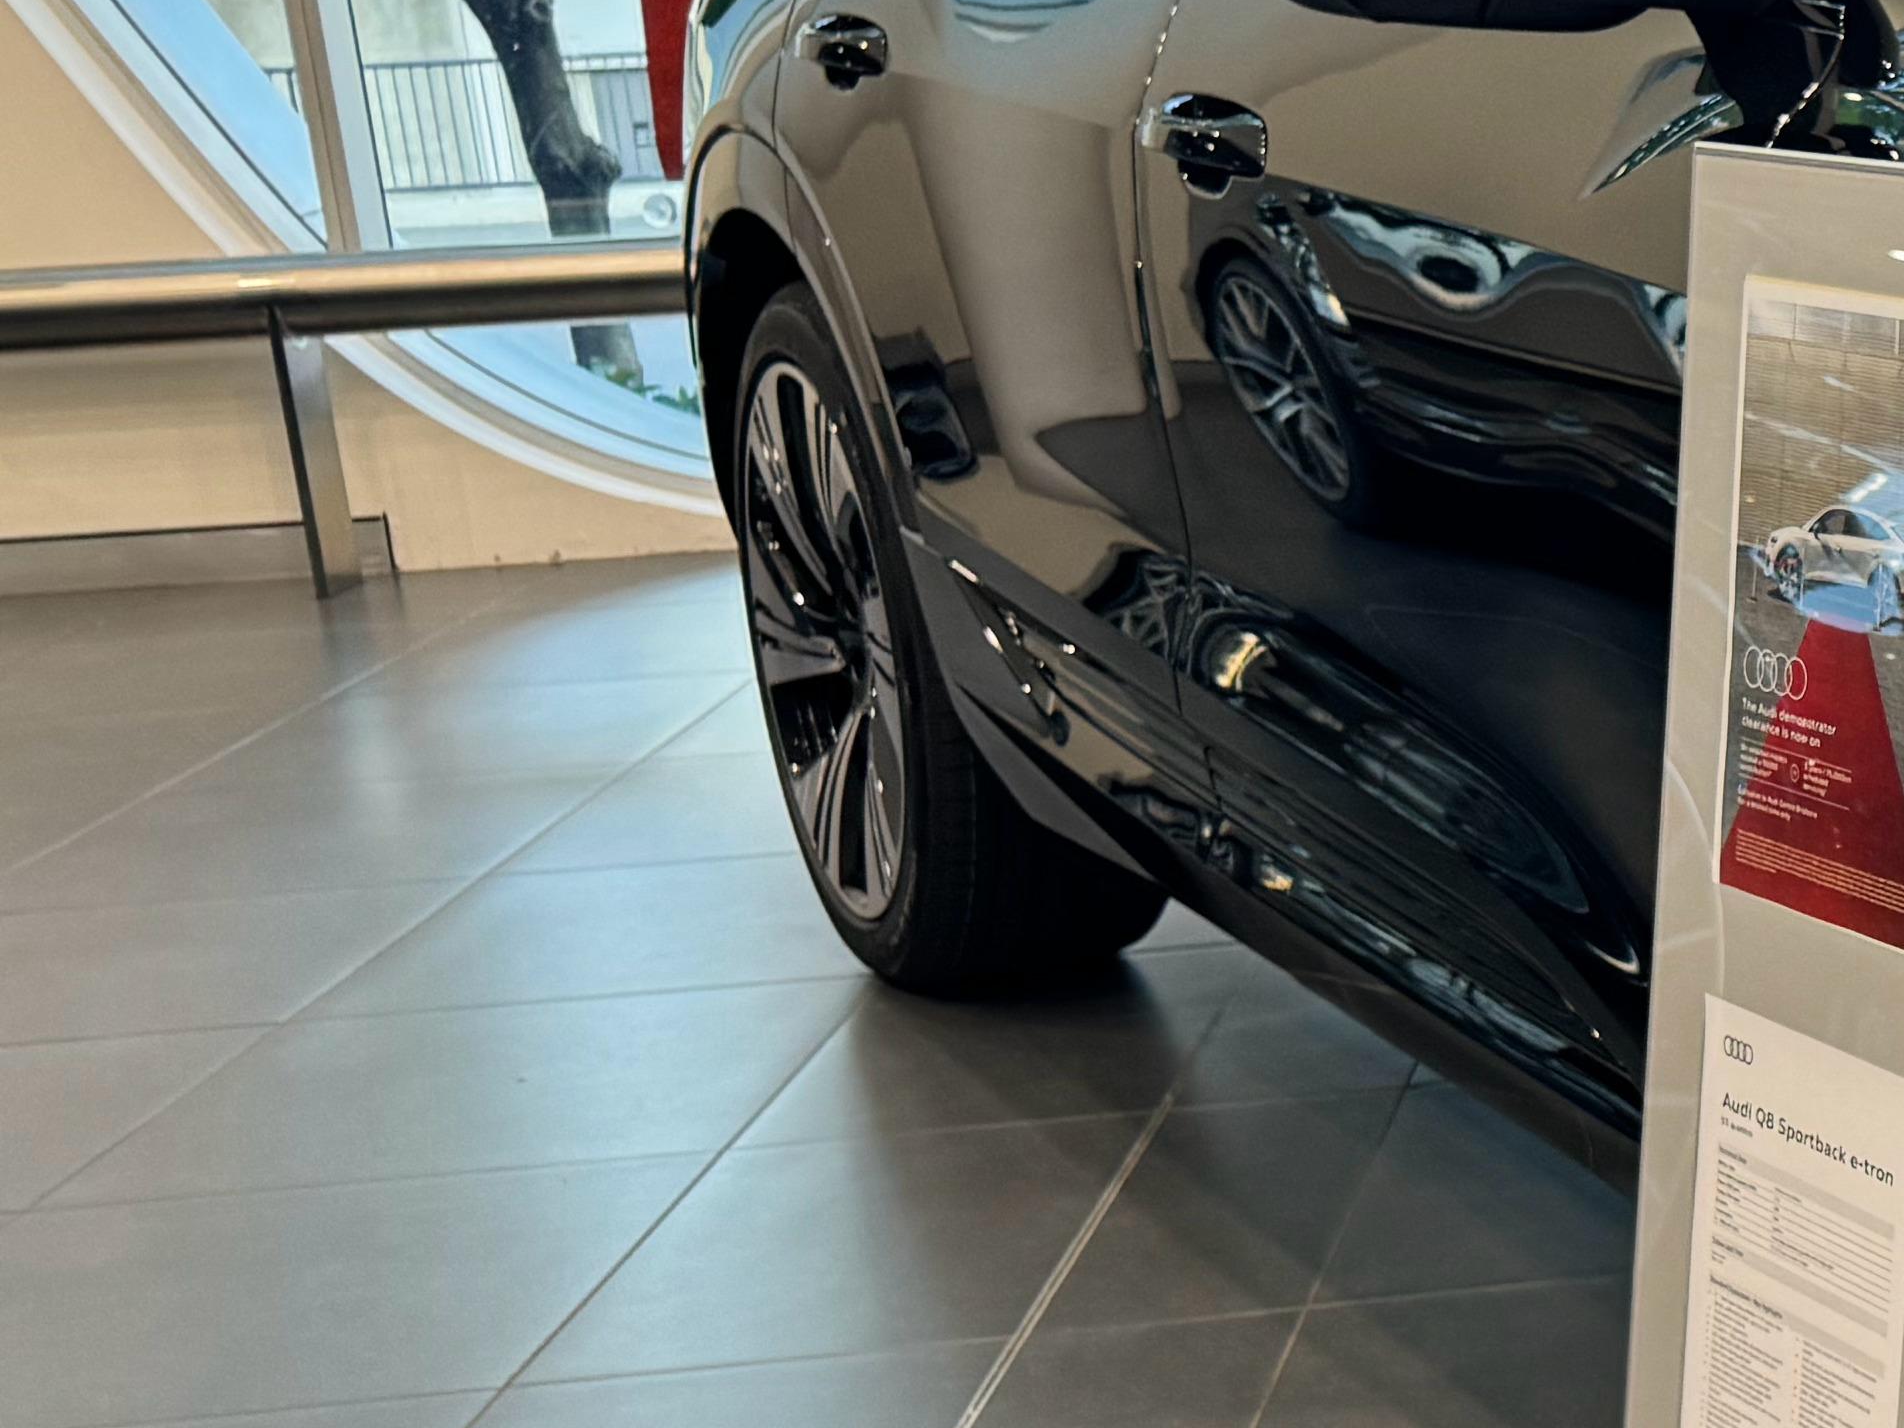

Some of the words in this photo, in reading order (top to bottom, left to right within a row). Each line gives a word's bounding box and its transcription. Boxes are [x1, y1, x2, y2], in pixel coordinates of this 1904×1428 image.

[1741, 696, 1757, 712] The
[1722, 1092, 1752, 1120] Audi
[1756, 1107, 1774, 1130] Q8
[1777, 1117, 1847, 1163] Sportback
[1850, 1155, 1894, 1186] e-tron
